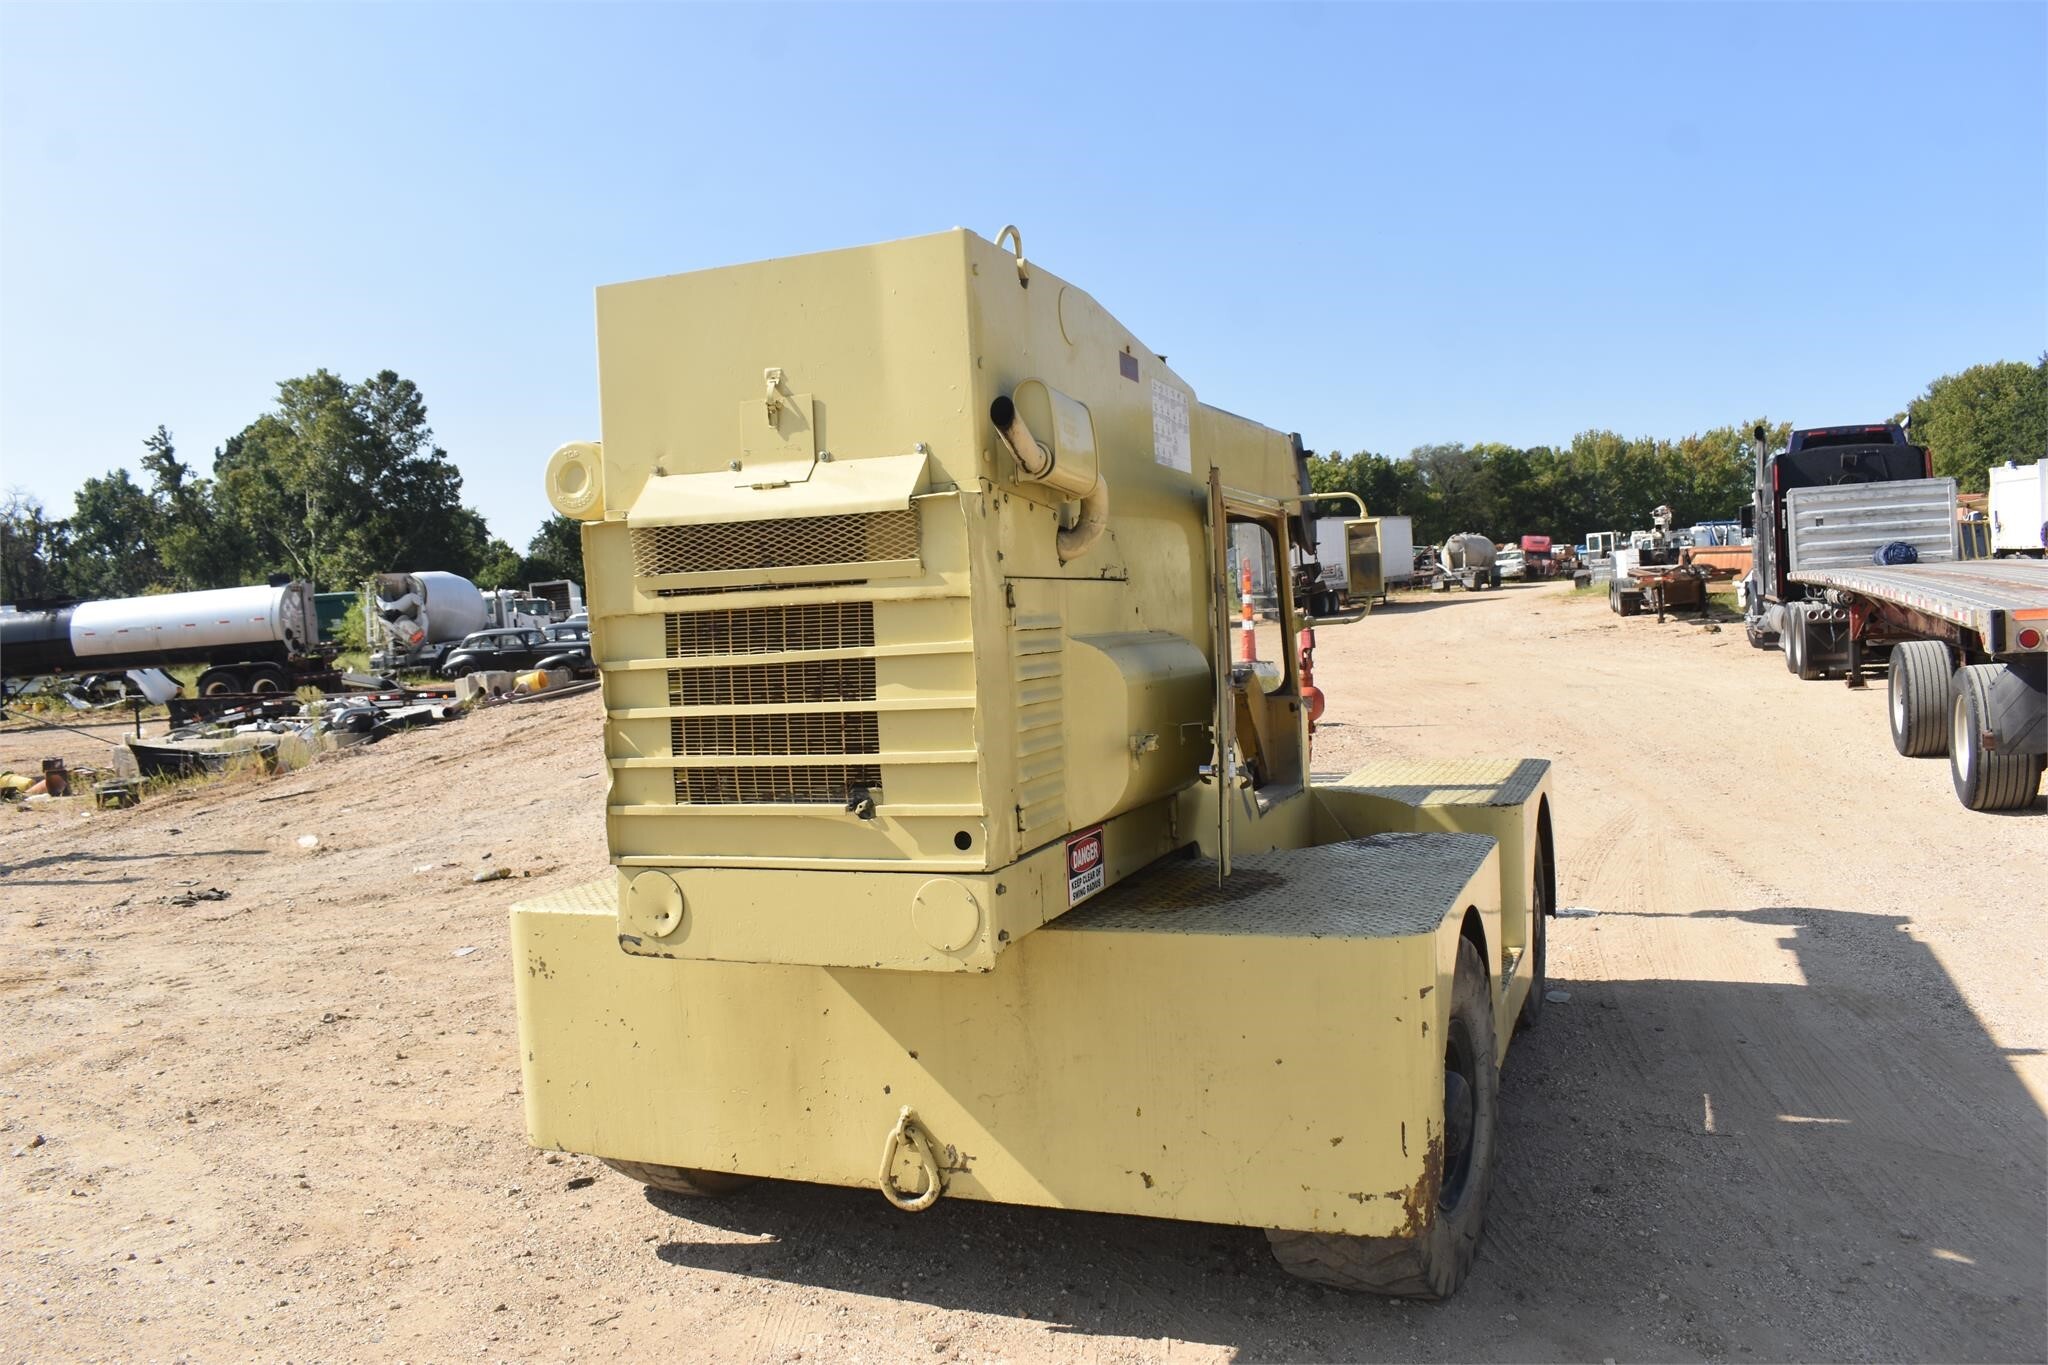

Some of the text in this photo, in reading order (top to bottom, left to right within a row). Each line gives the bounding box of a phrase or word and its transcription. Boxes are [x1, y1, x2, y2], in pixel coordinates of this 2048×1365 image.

[1073, 842, 1099, 868] DANGER
[1071, 867, 1101, 890] KEEP CLEAR OF
[1072, 878, 1101, 900] SWING RADIUS
